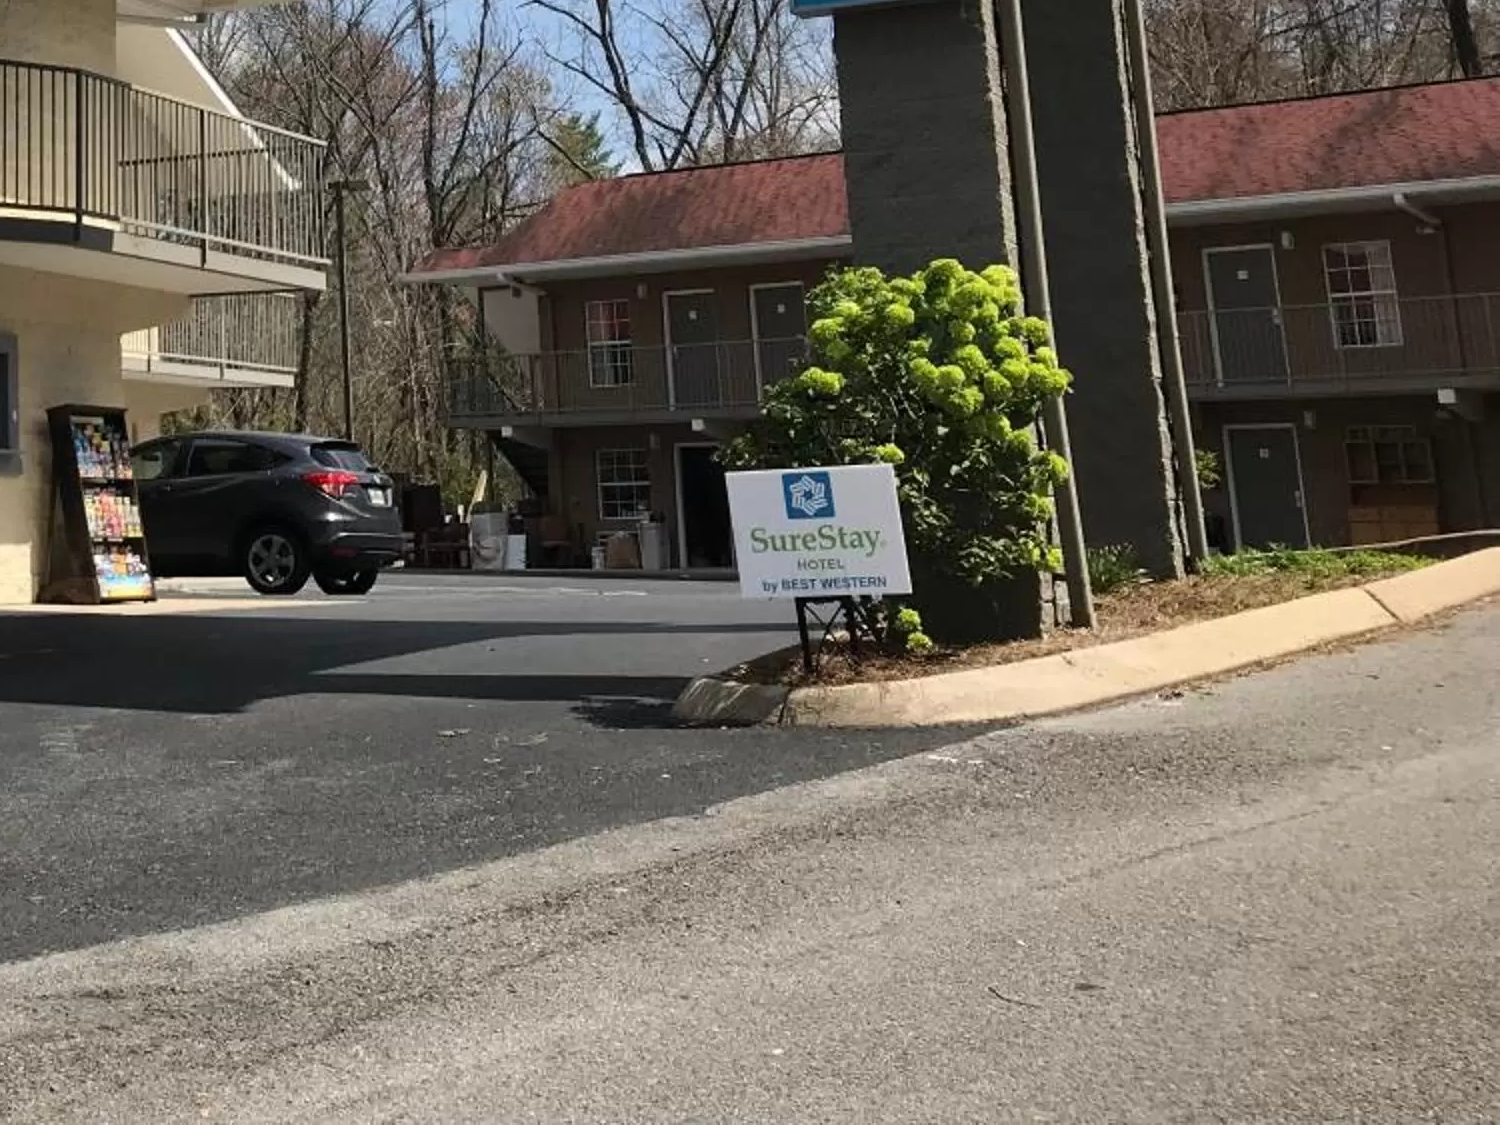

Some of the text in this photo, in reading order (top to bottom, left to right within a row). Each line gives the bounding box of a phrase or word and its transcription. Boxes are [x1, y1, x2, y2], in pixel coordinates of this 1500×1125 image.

[750, 524, 881, 557] SureStay
[797, 558, 845, 571] HOTEL
[762, 575, 887, 592] by BEST WESTERN
